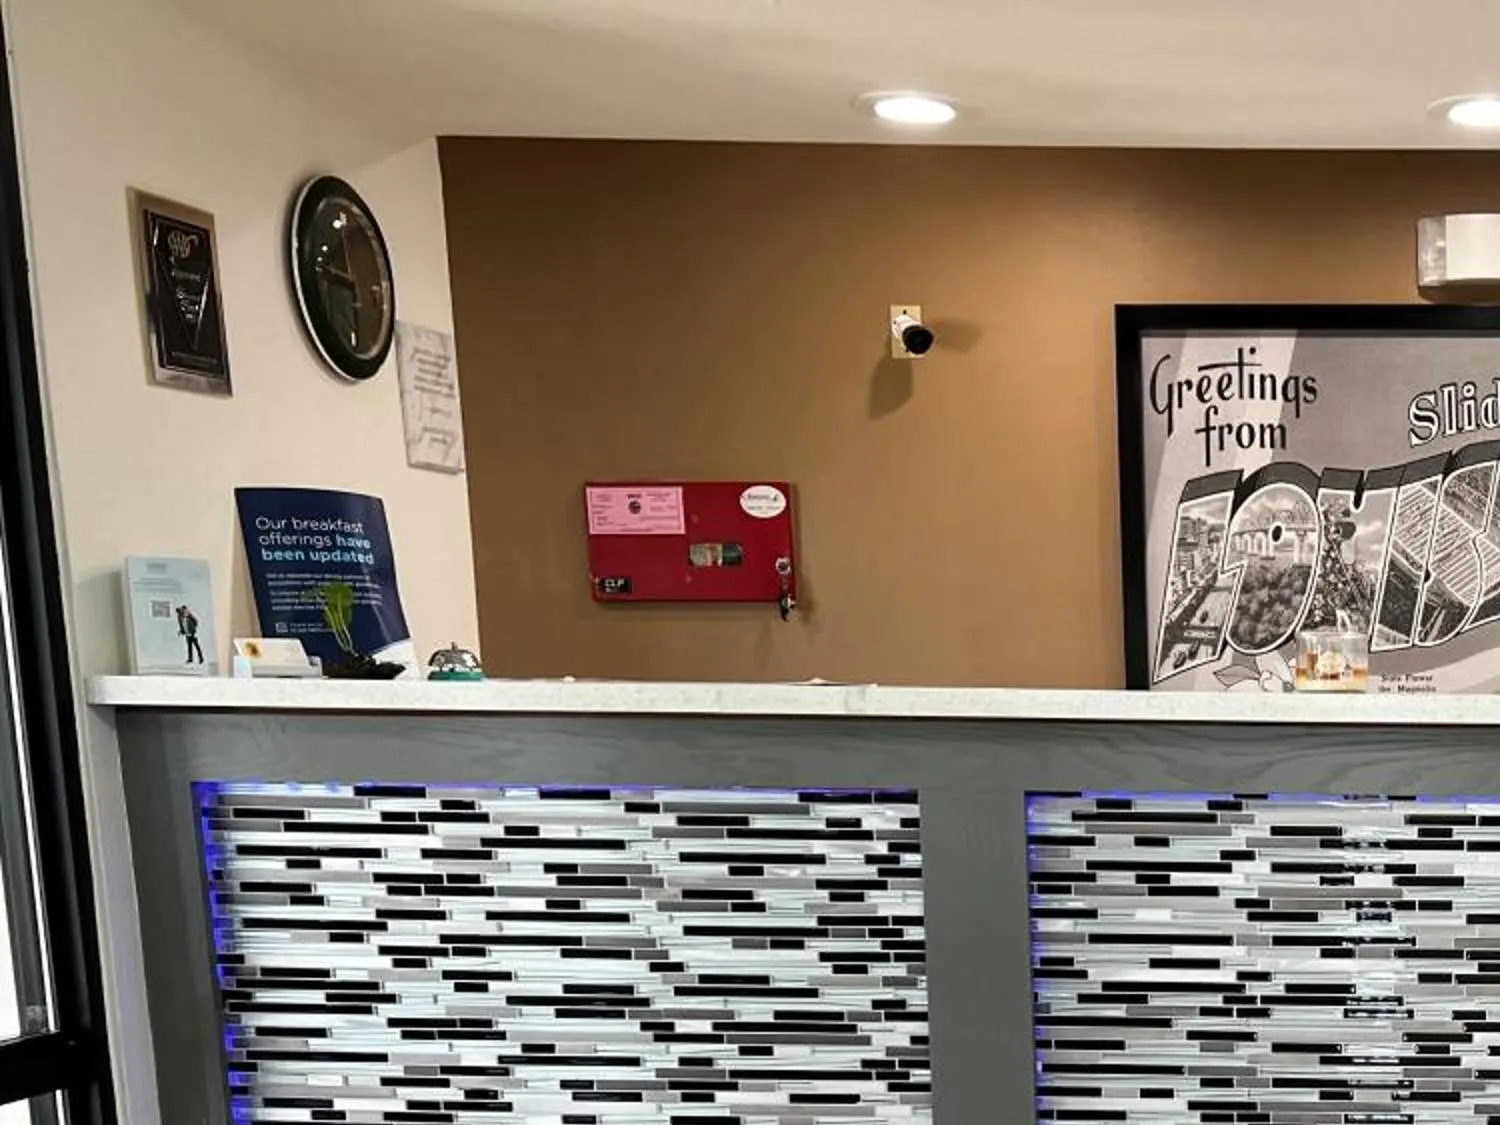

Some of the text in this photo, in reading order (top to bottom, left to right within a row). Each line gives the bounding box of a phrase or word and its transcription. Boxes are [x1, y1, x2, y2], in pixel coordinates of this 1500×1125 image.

[1150, 347, 1318, 438] Greetings
[1195, 405, 1288, 467] from
[255, 516, 364, 534] Our breakfast
[259, 531, 371, 549] offerings have
[261, 547, 375, 565] been updated
